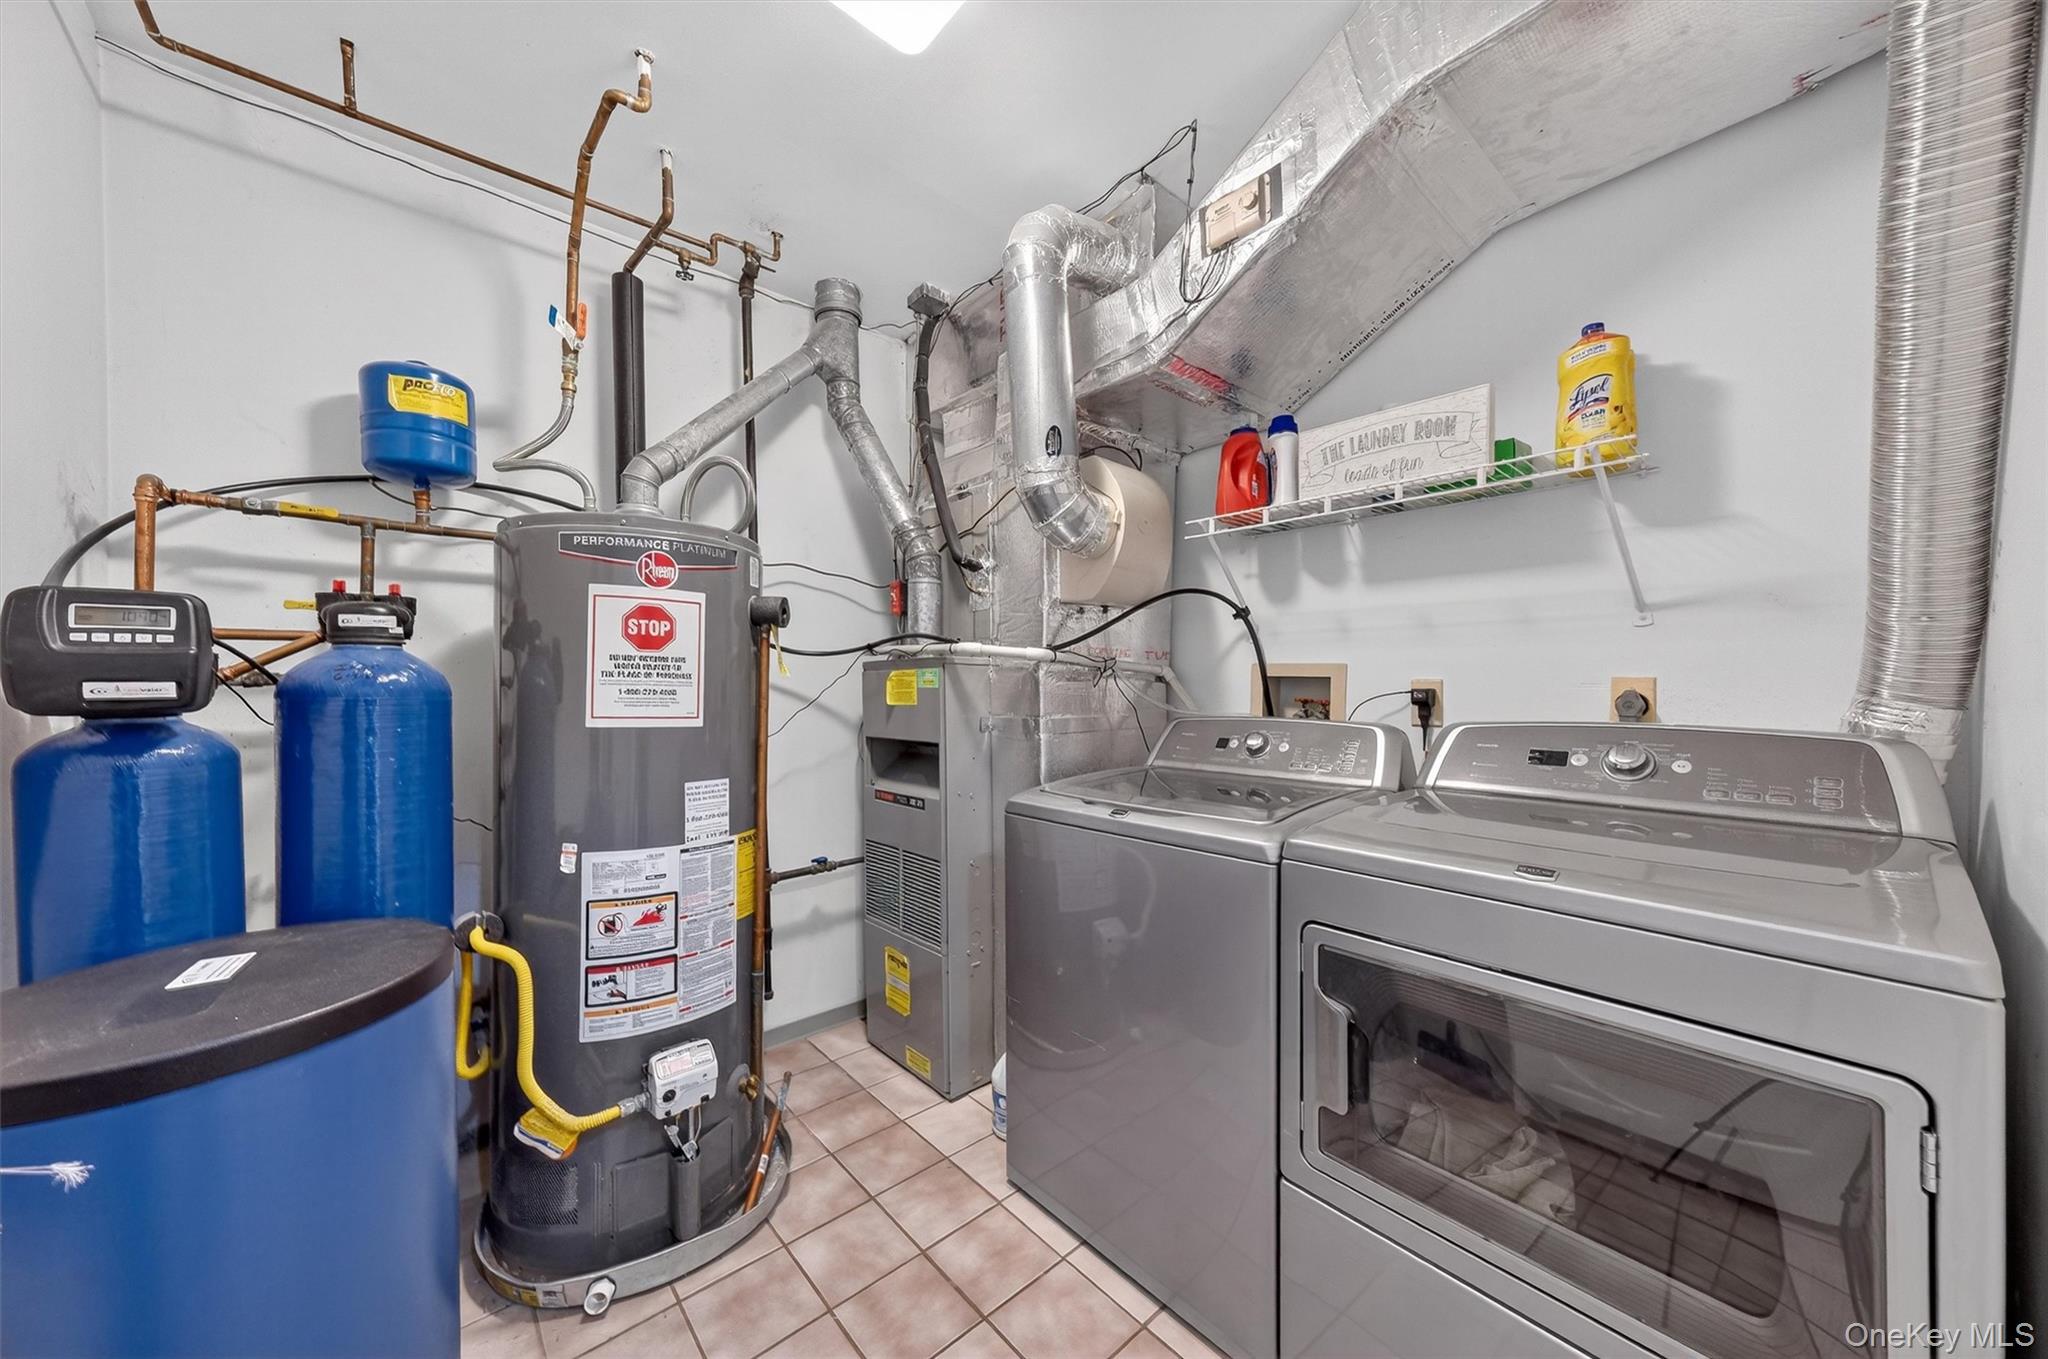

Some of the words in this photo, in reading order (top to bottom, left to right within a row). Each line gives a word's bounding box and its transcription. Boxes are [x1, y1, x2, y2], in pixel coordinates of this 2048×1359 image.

[1569, 376, 1609, 410] Lysol
[1320, 441, 1345, 466] THE
[1350, 422, 1408, 456] LAUNDRY
[1414, 415, 1457, 440] ROOM
[573, 535, 670, 551] PERFORMANCE
[672, 541, 727, 559] PLATINUM
[641, 551, 675, 583] Rheem
[627, 618, 671, 637] STOP
